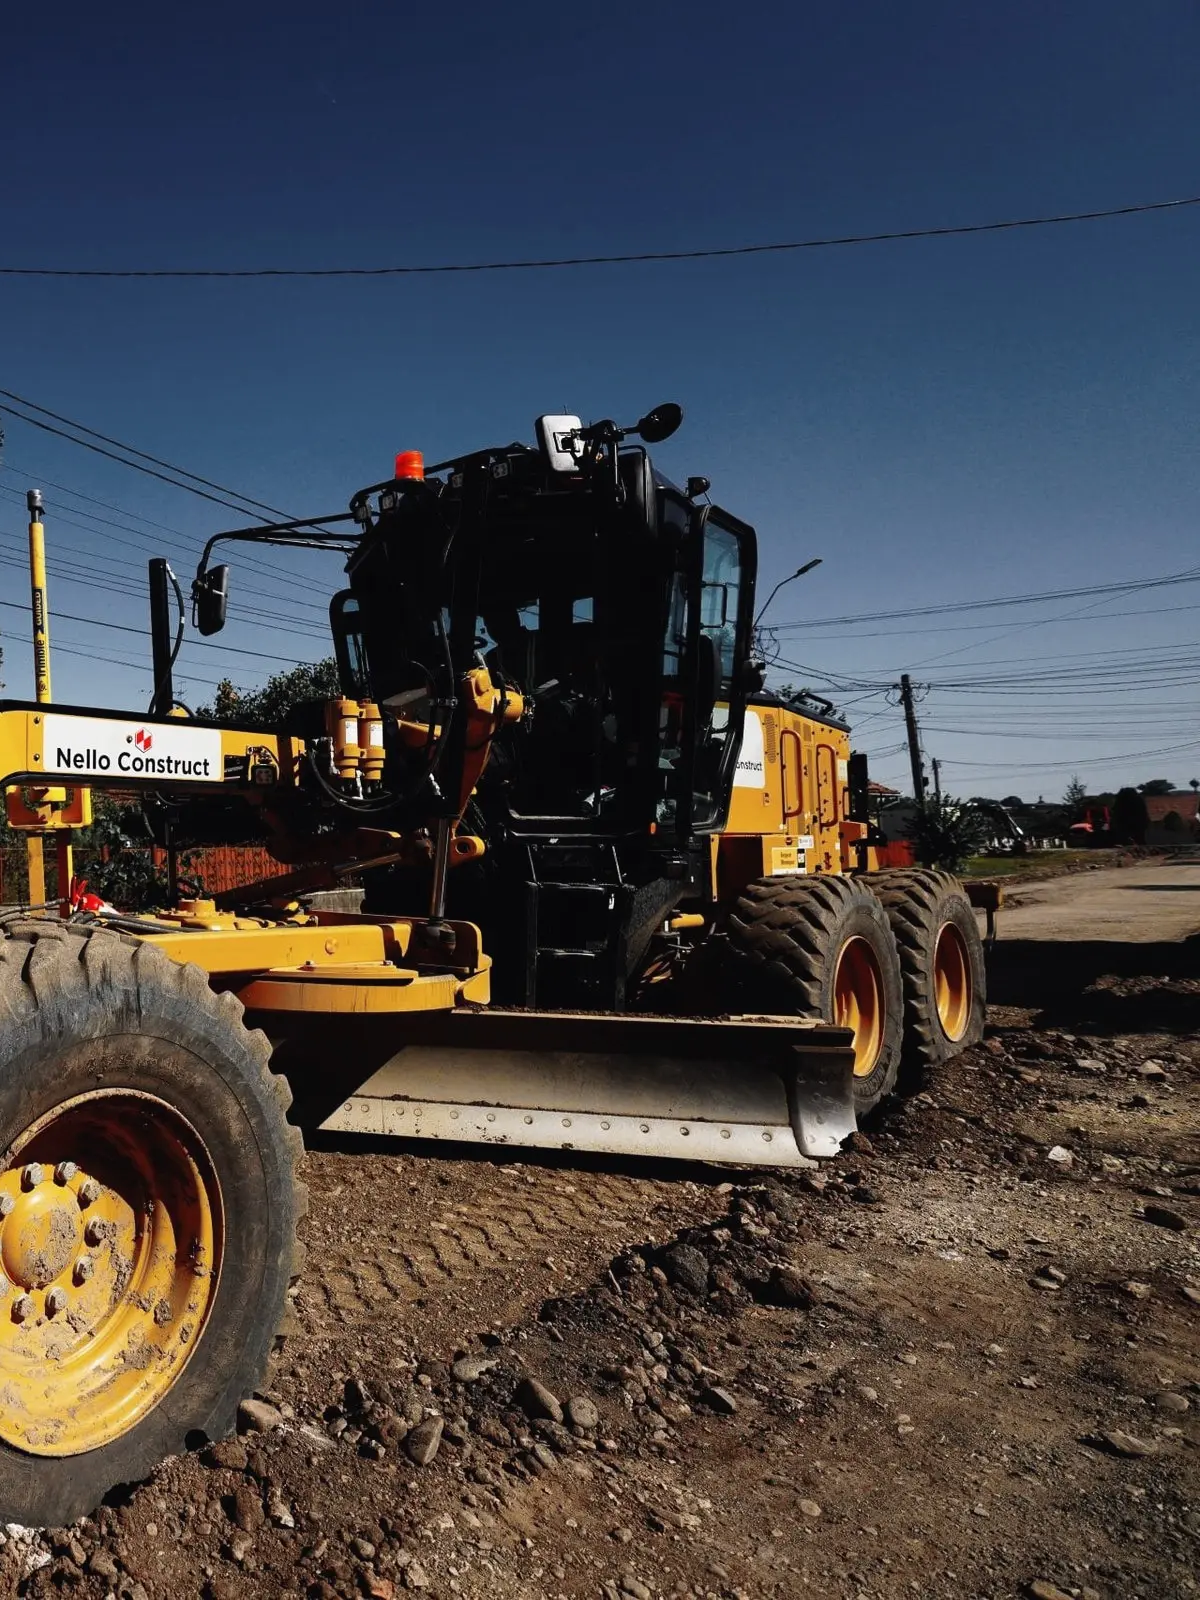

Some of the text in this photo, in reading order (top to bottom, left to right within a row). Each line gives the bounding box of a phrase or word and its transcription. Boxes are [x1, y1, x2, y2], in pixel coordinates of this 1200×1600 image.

[36, 640, 46, 677] Trimble
[56, 748, 209, 776] Nello Construct
[736, 761, 762, 771] onstruct
